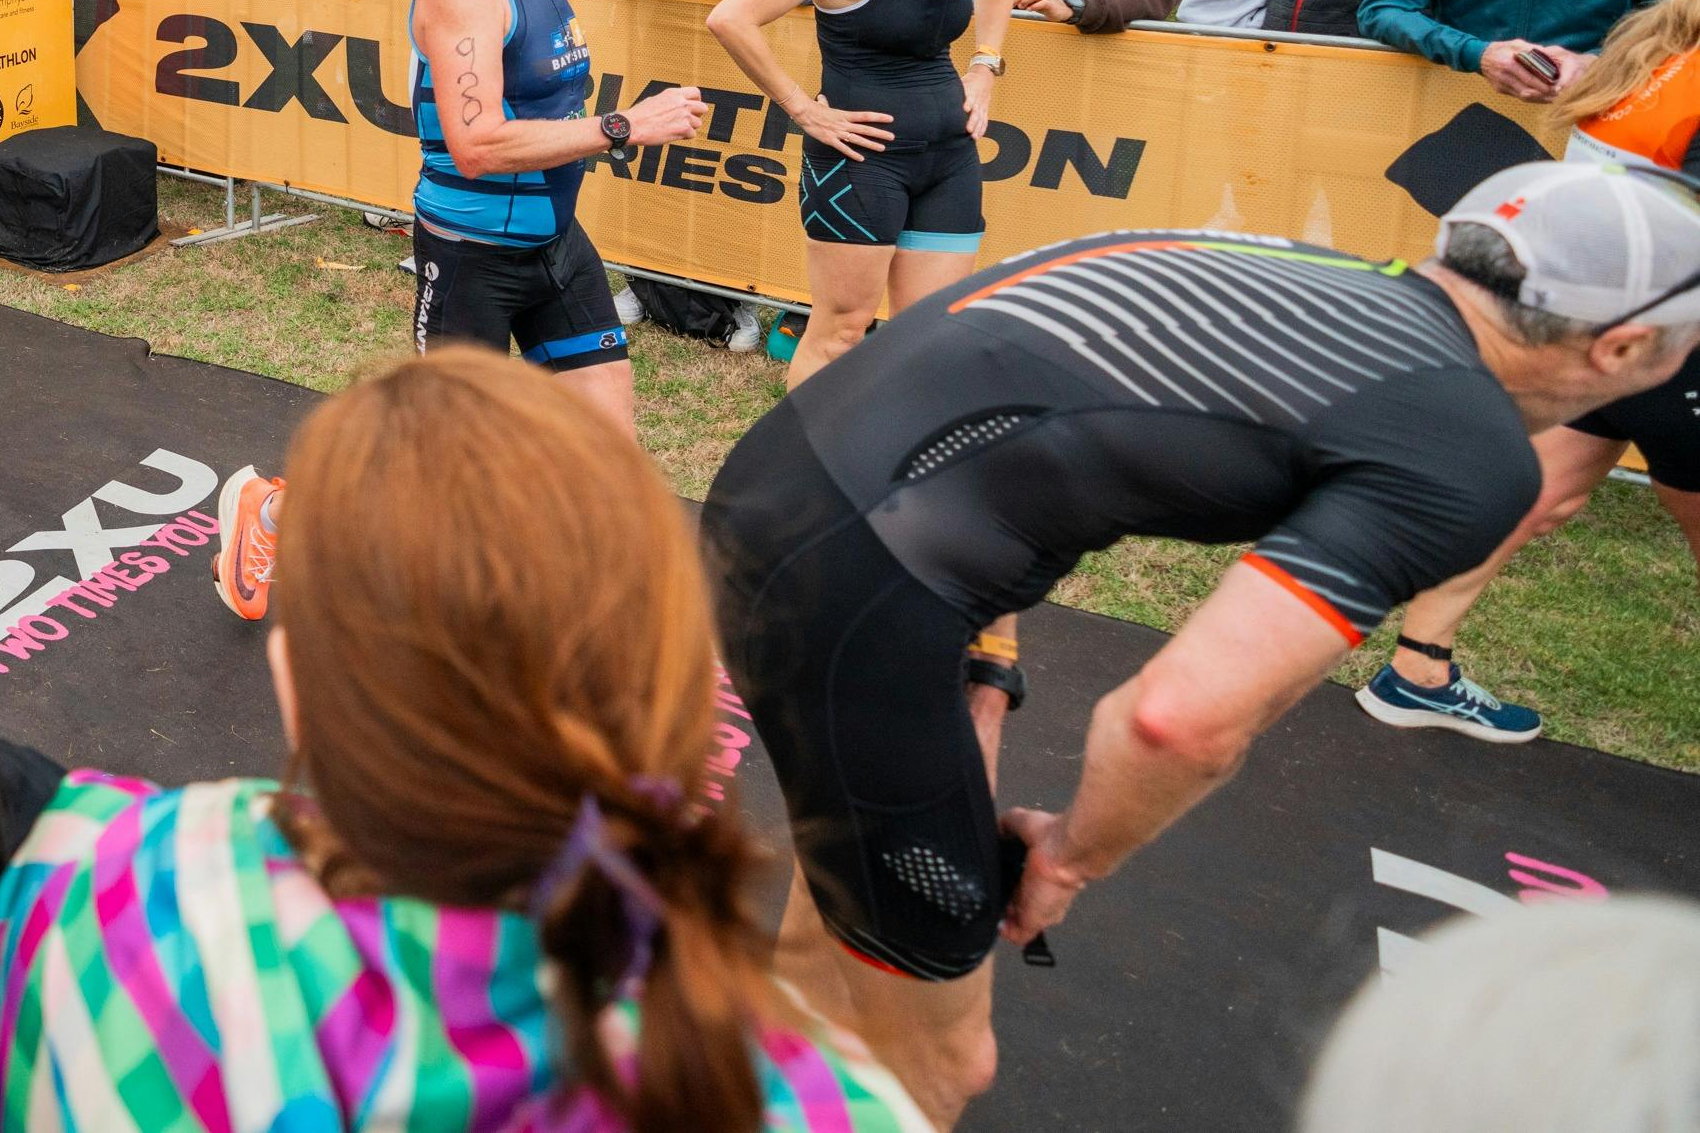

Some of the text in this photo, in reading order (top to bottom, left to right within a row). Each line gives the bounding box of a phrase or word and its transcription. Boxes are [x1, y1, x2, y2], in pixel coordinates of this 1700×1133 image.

[9, 8, 19, 17] and
[19, 5, 35, 15] fitness
[551, 46, 590, 71] BAYSID
[10, 114, 39, 130] Bayside
[43, 550, 171, 619] TIMES
[139, 509, 221, 557] YOU
